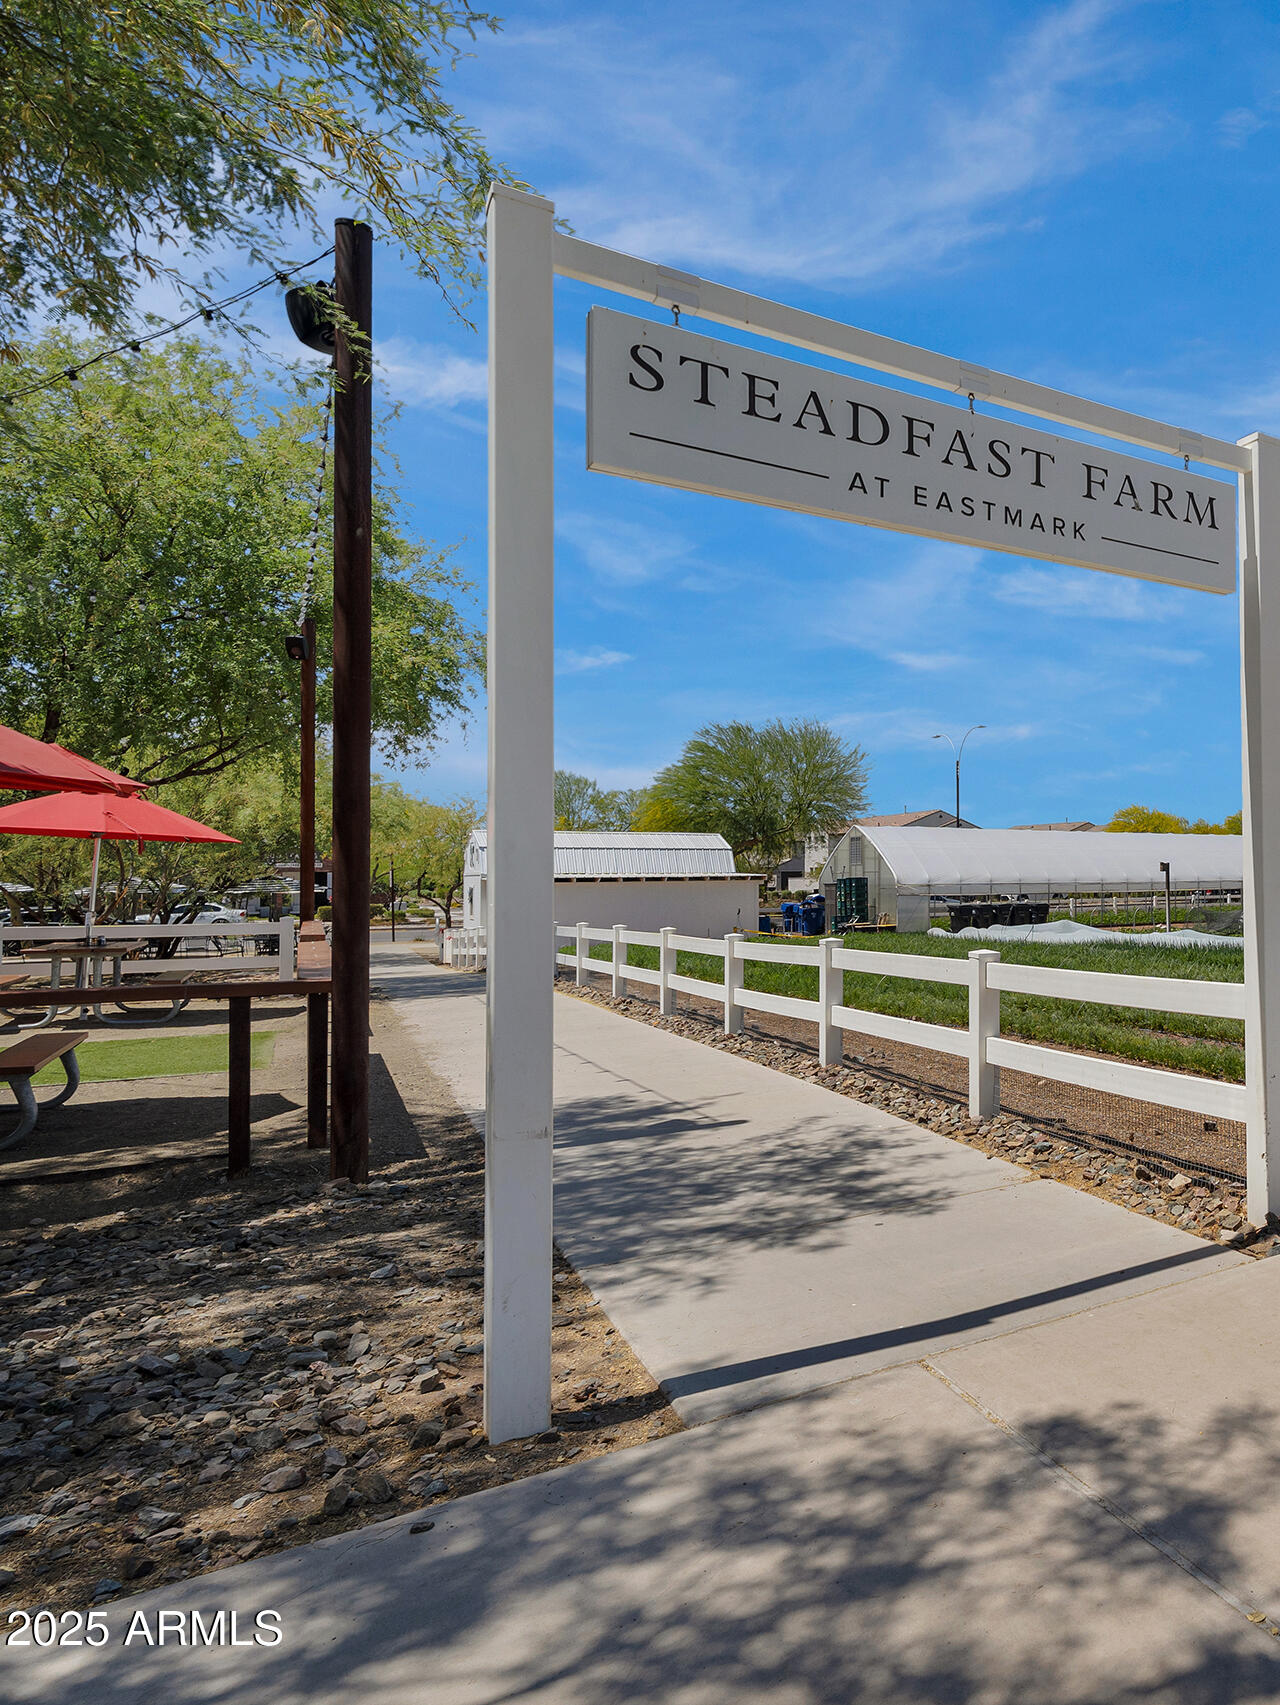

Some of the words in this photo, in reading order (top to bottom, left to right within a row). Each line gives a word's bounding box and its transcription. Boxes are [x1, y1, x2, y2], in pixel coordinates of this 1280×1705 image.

[628, 343, 1056, 488] STEADFAST
[1081, 463, 1220, 531] FARM
[848, 472, 890, 499] AT
[914, 485, 1088, 542] EASTMARK
